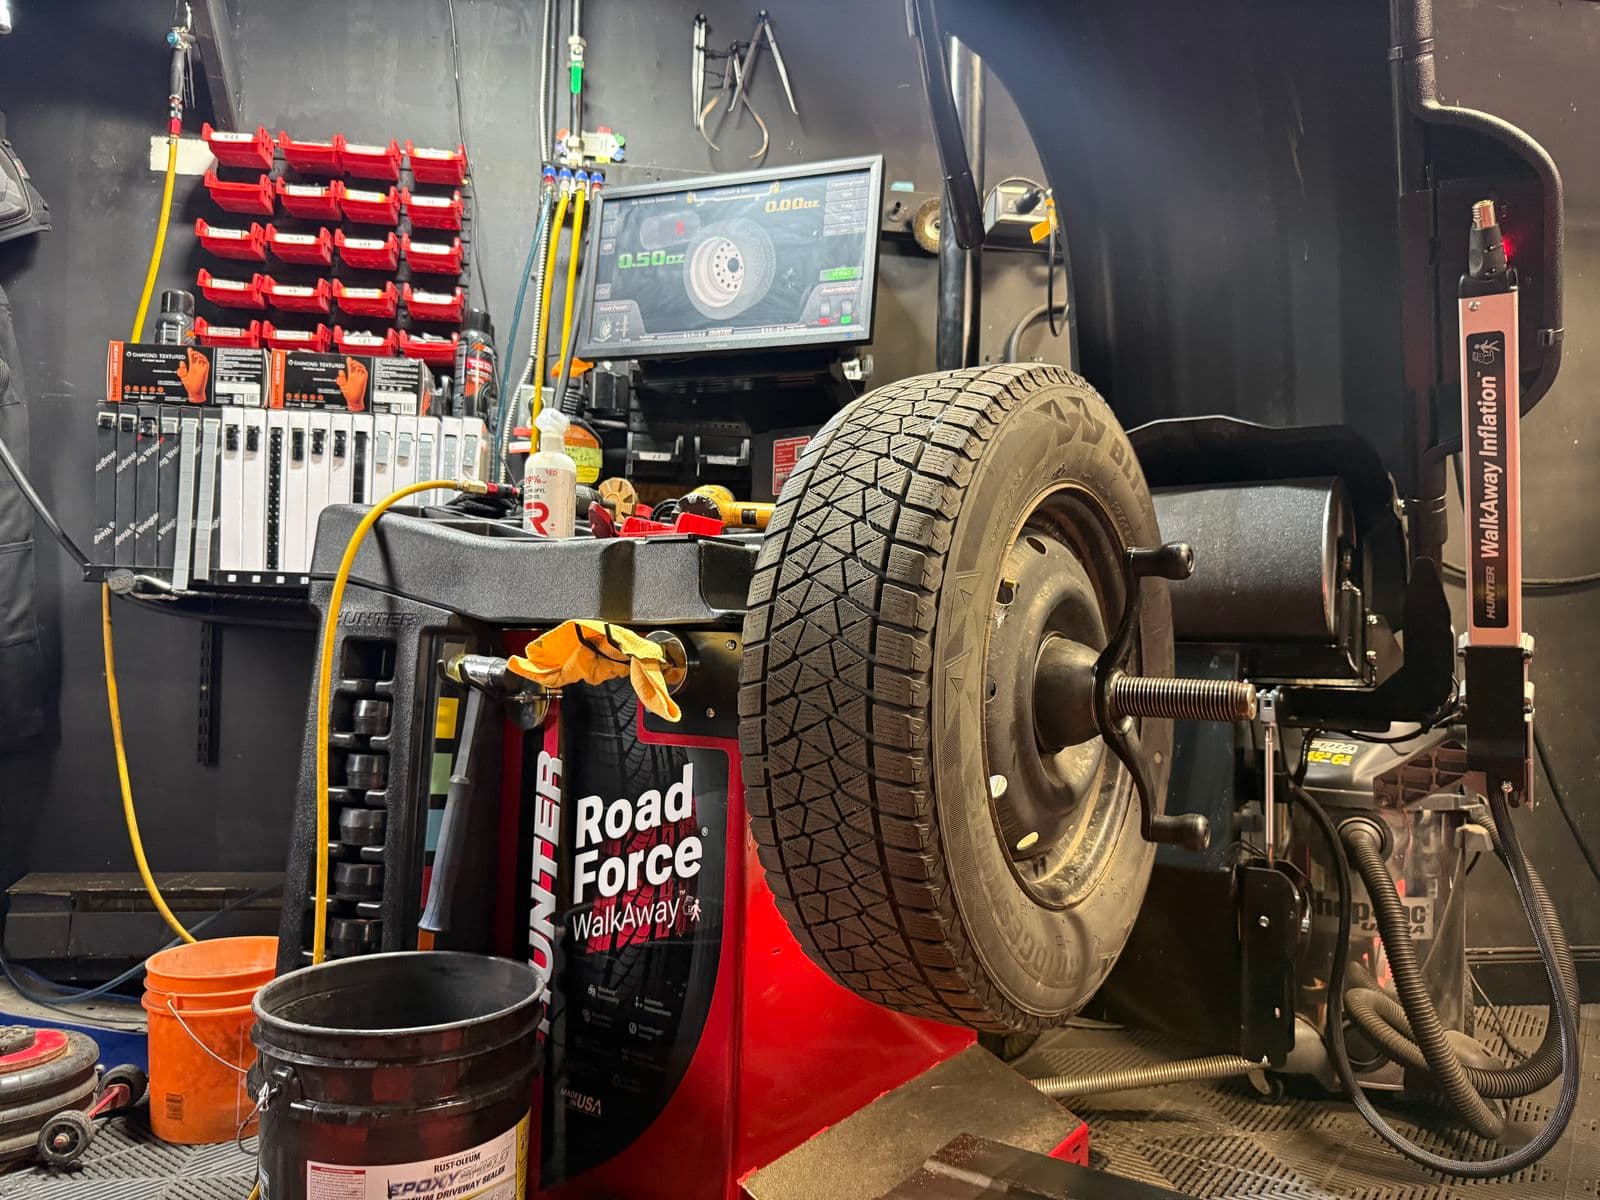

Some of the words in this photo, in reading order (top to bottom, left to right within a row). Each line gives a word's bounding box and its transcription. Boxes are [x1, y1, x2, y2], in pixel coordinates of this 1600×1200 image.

[1476, 375, 1498, 458] Inflation
[1479, 461, 1503, 559] WalkAway
[1485, 566, 1497, 619] HUNTER
[575, 762, 694, 849] Road
[573, 835, 703, 904] Force
[572, 897, 681, 941] WalkAway
[577, 1094, 601, 1115] USA
[434, 1152, 481, 1173] RUST-OLEUM
[436, 1181, 481, 1200] DRIVEWAY
[482, 1165, 506, 1183] SEALER
